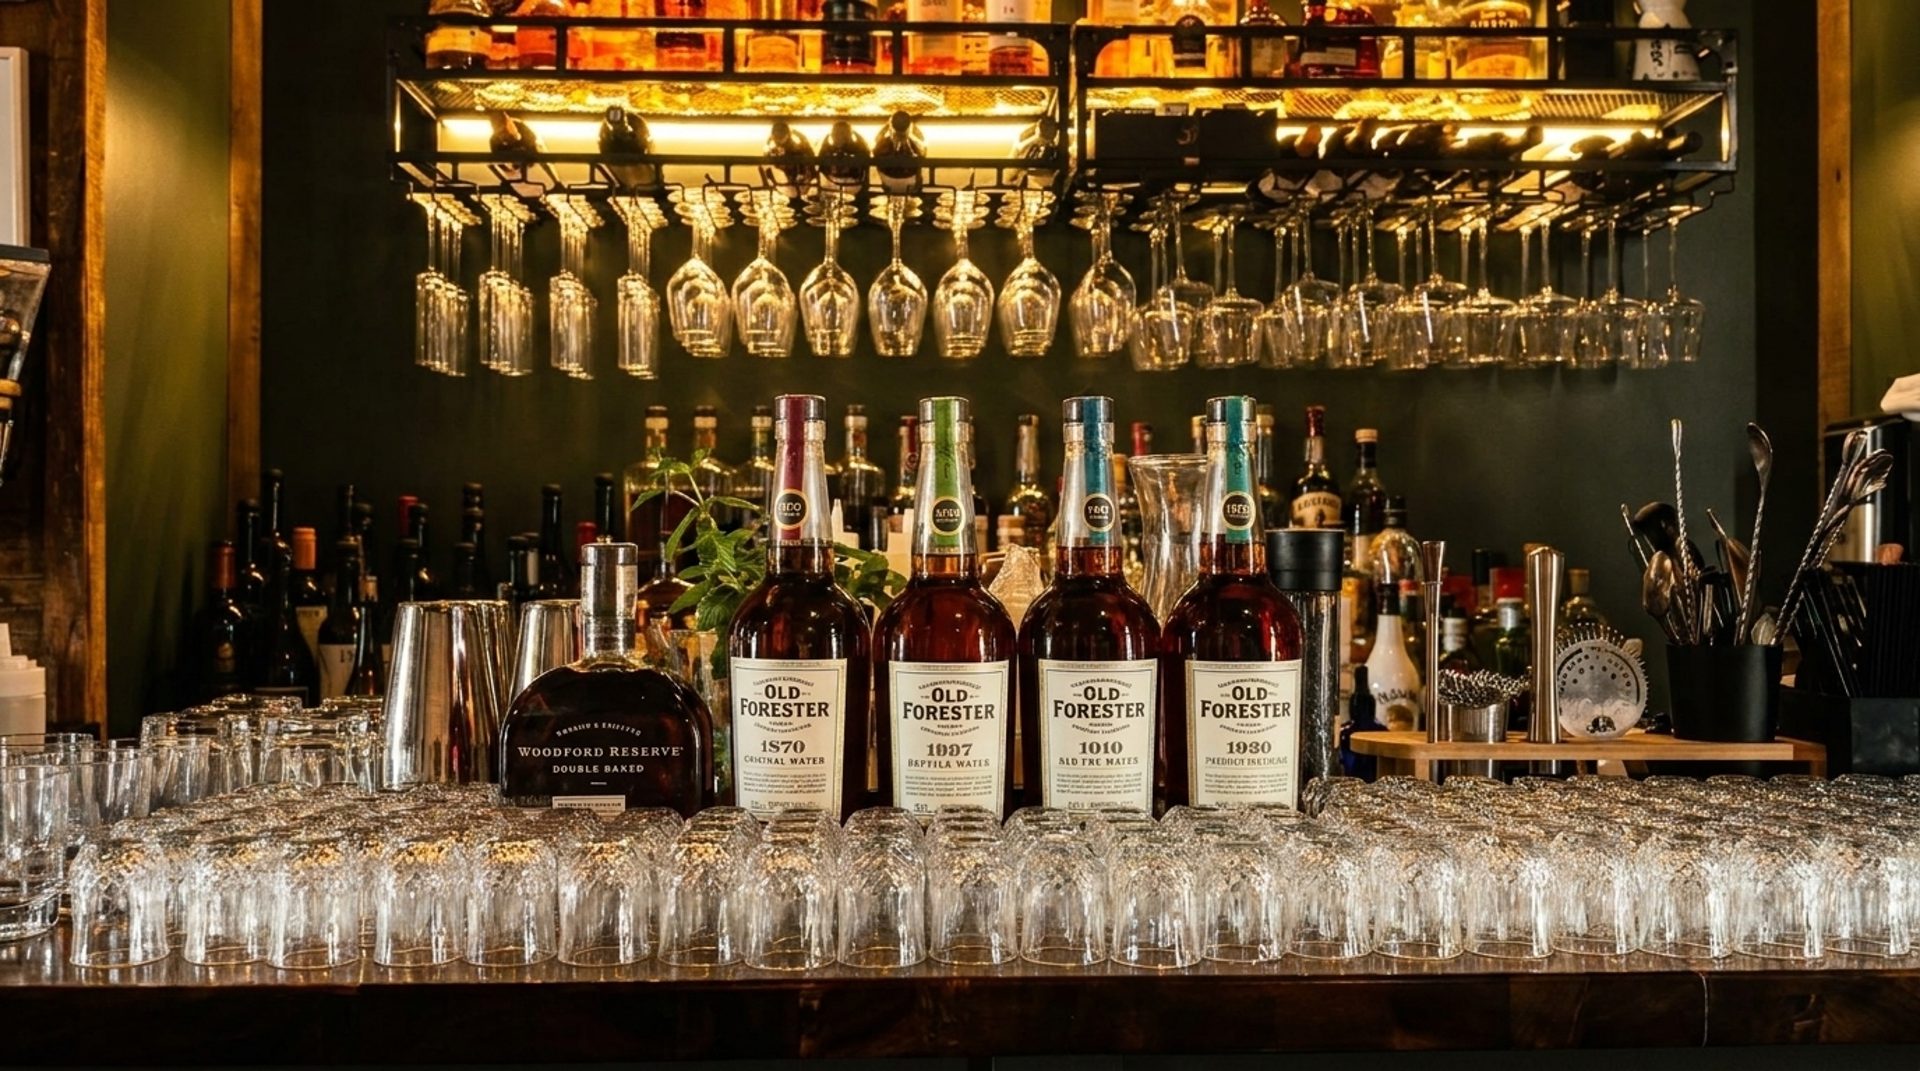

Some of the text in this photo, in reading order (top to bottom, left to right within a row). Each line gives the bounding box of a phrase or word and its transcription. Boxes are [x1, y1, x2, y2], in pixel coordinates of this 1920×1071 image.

[764, 683, 801, 700] OLD
[931, 686, 968, 703] OLD
[1083, 685, 1120, 701] OLD
[1231, 685, 1268, 701] OLD
[740, 697, 830, 718] FORESTER
[902, 701, 995, 721] FORESTER
[1053, 699, 1145, 719] FORESTER
[1200, 699, 1291, 719] FORESTER
[517, 745, 682, 758] WOODFORD RESERVE
[552, 763, 645, 774] DOUBLE BAKED
